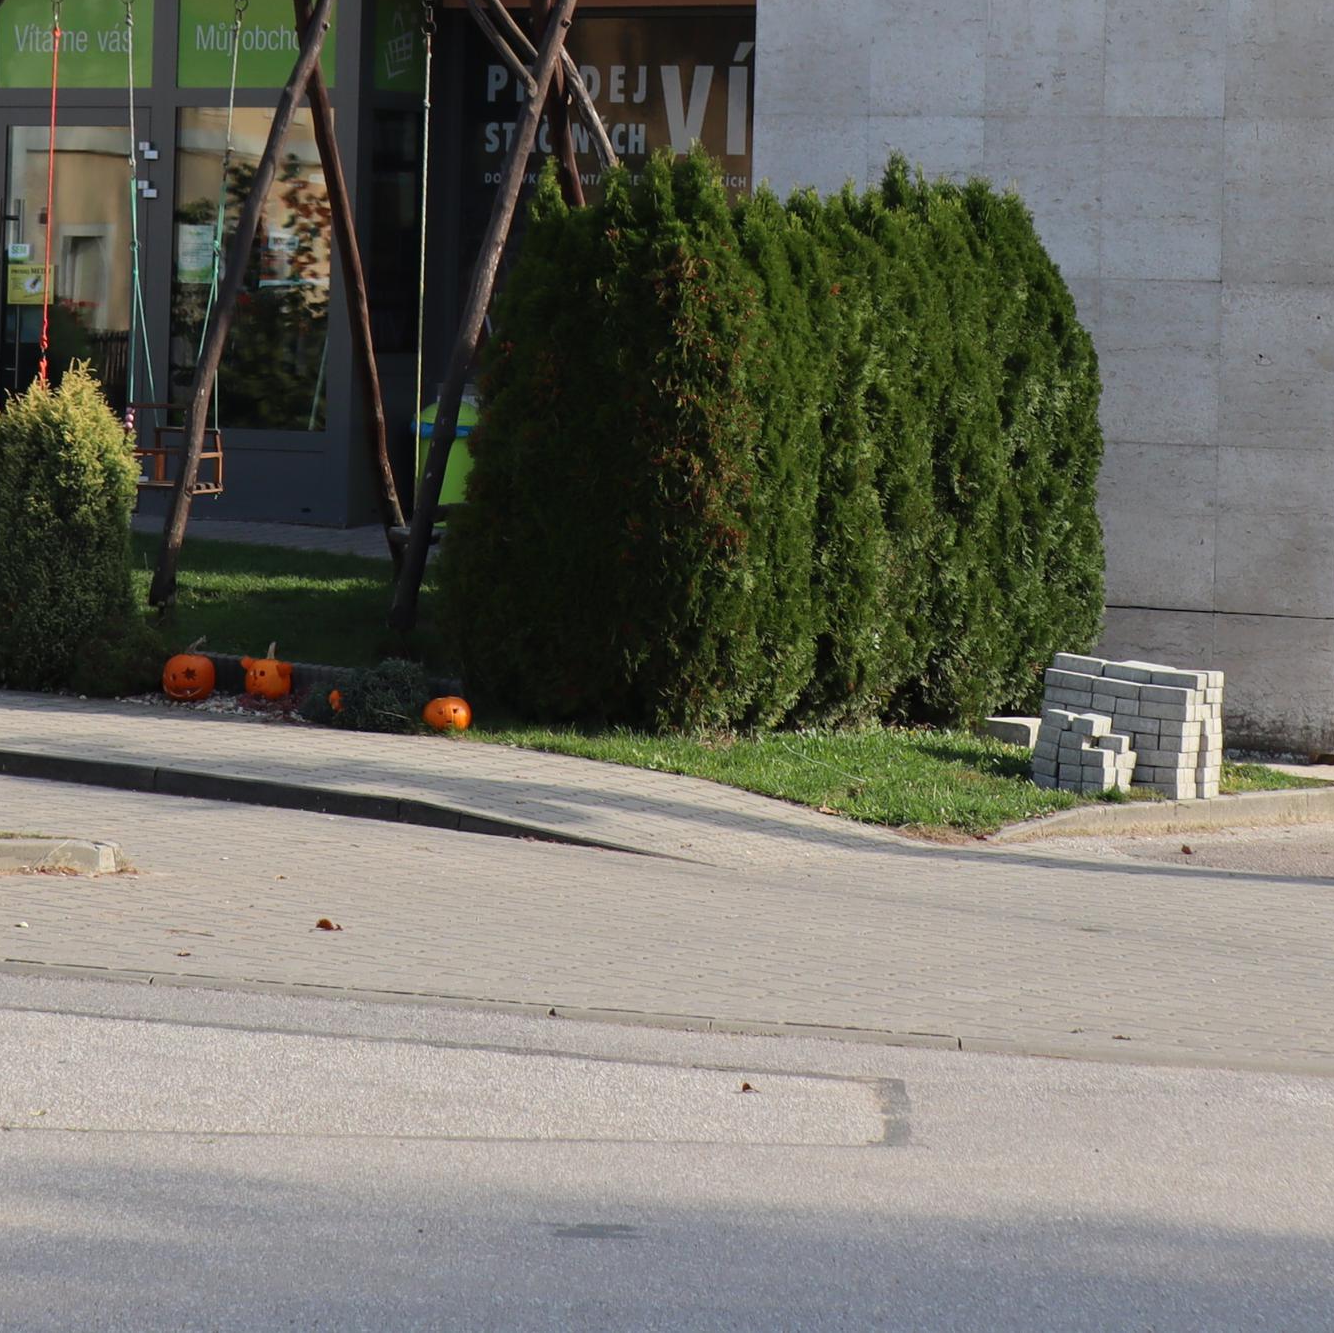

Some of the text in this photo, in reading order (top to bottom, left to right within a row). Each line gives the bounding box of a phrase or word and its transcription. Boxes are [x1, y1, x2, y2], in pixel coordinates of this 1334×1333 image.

[13, 22, 132, 53] Vítáme vás
[196, 22, 301, 57] Můj obcho
[486, 64, 648, 105] PDEJ
